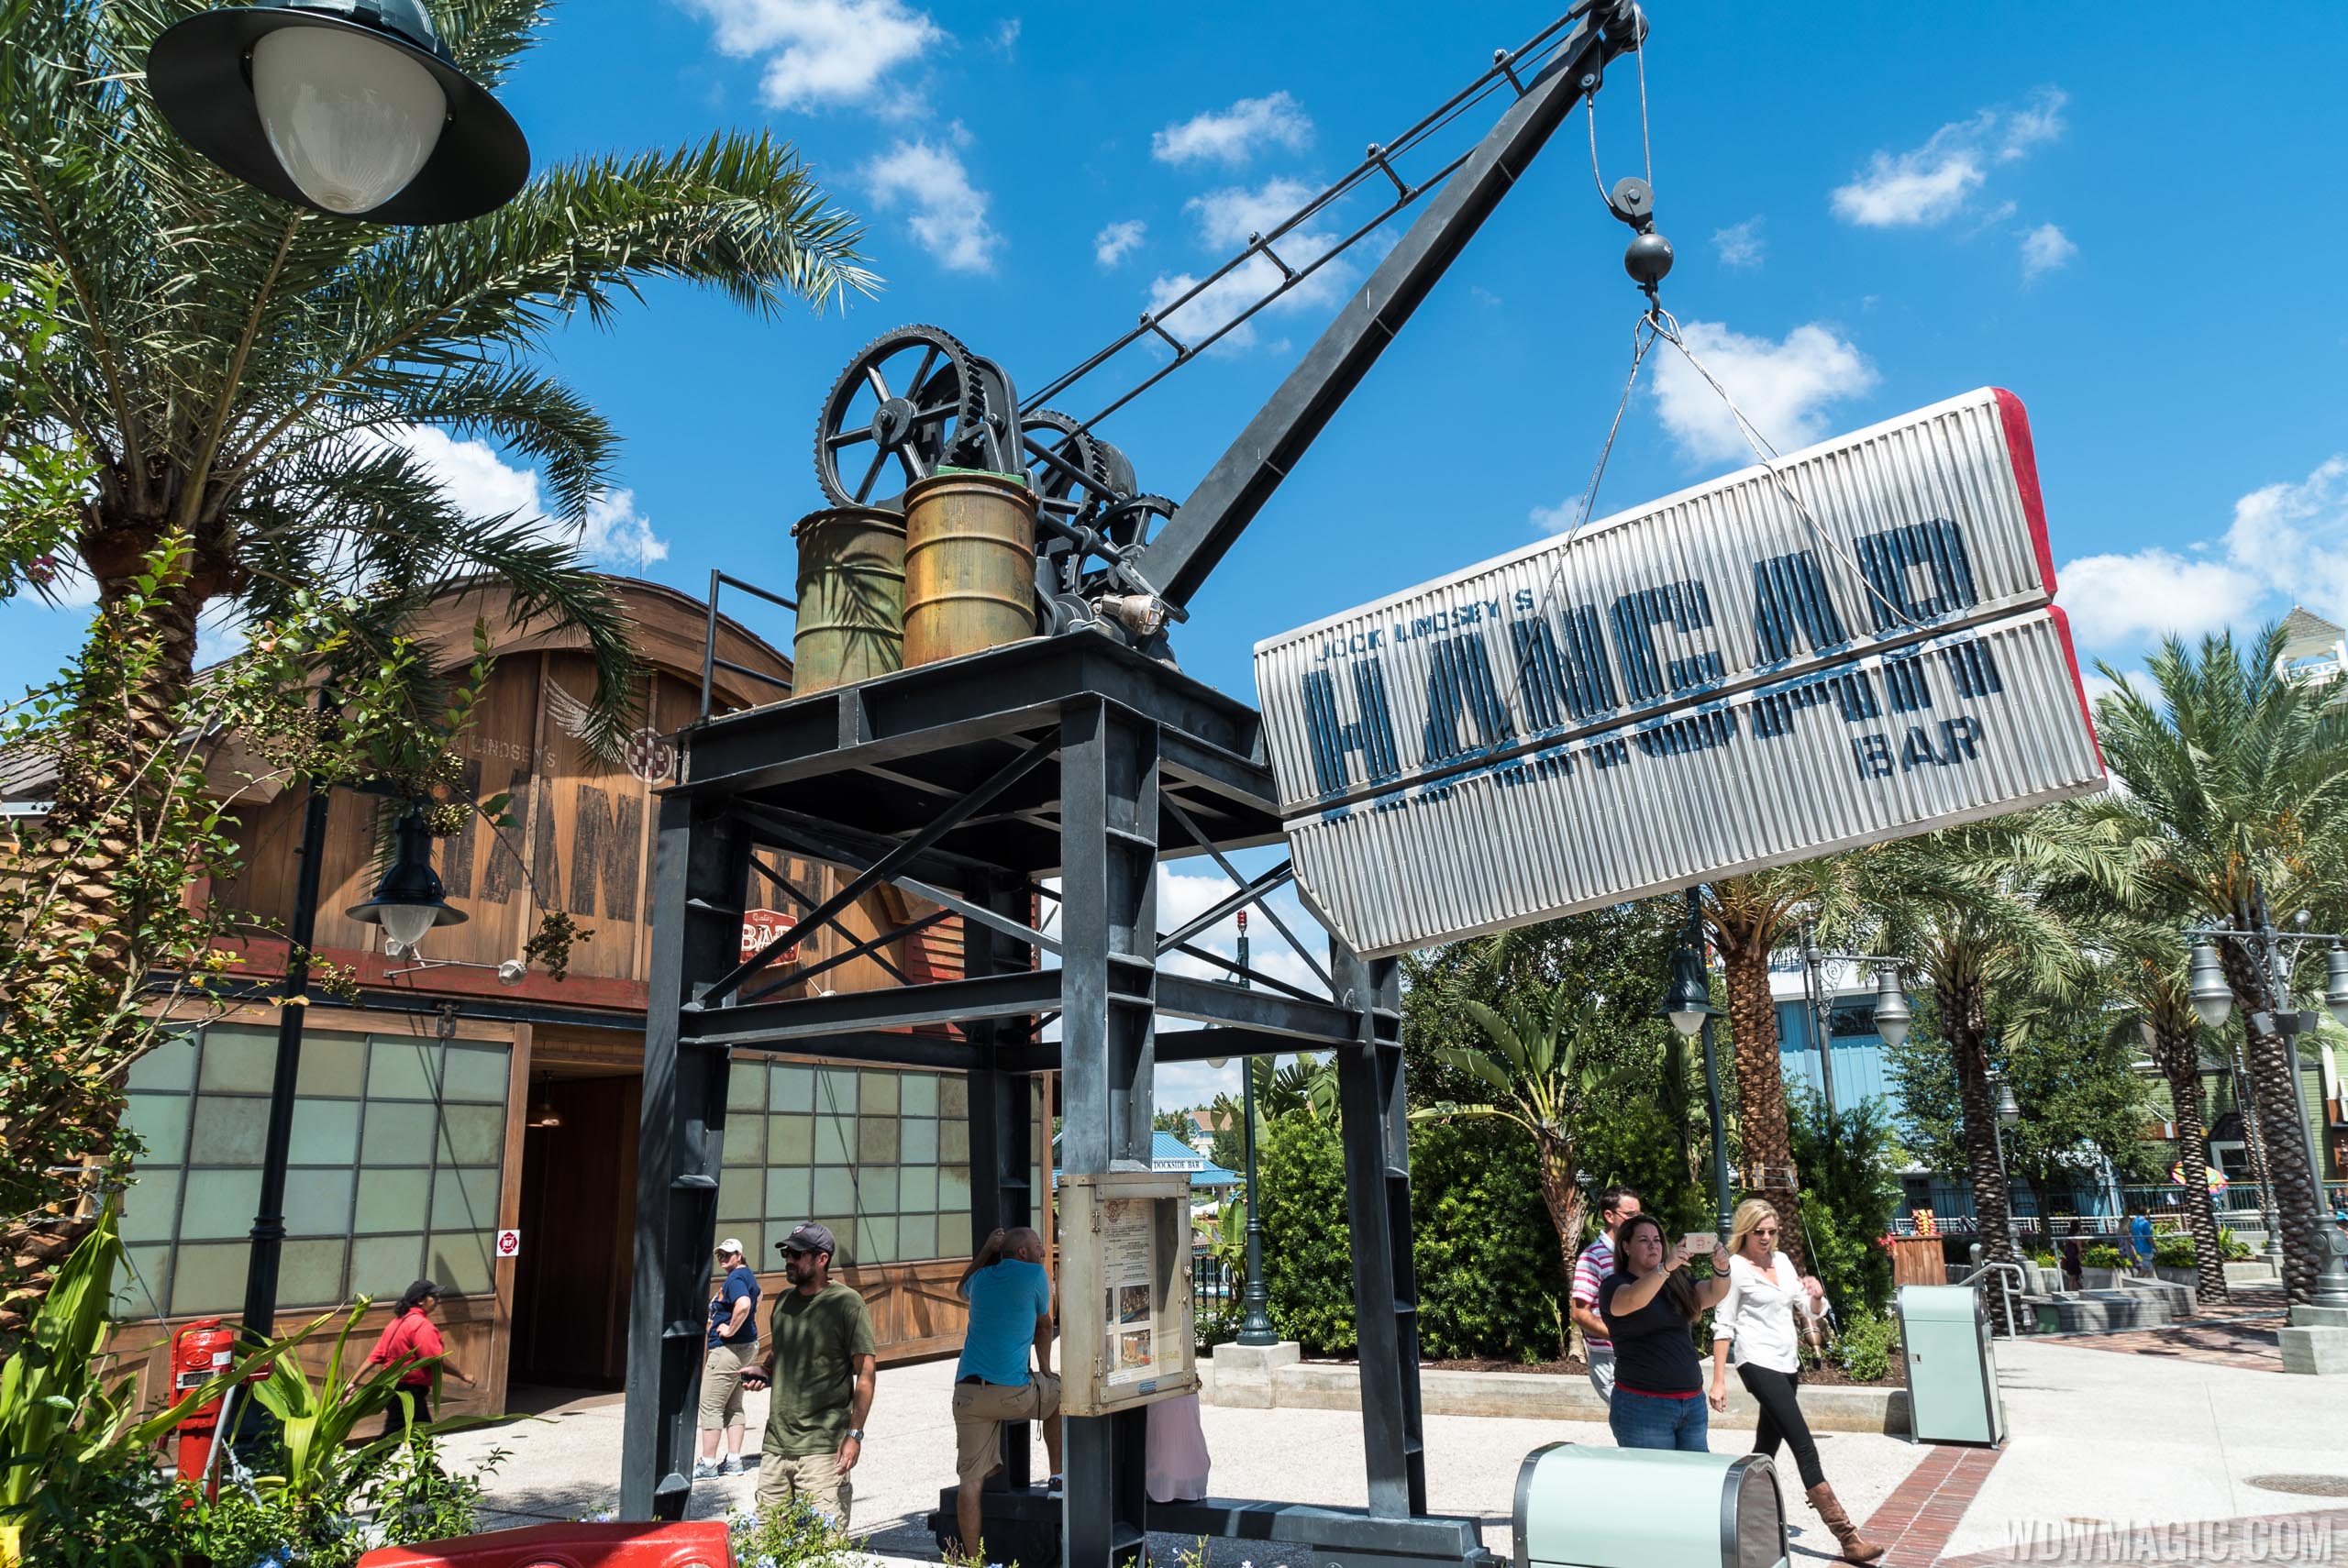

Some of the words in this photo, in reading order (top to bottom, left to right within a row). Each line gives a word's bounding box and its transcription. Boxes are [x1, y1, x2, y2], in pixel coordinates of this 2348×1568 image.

[1315, 628, 1385, 662] JOCK
[1394, 588, 1534, 643] LINDSEY'S
[1301, 517, 2003, 826] HANGAR
[1851, 716, 1982, 780] BAR
[1154, 1161, 1185, 1169] DOCKSIDE
[1187, 1161, 1200, 1169] BAR
